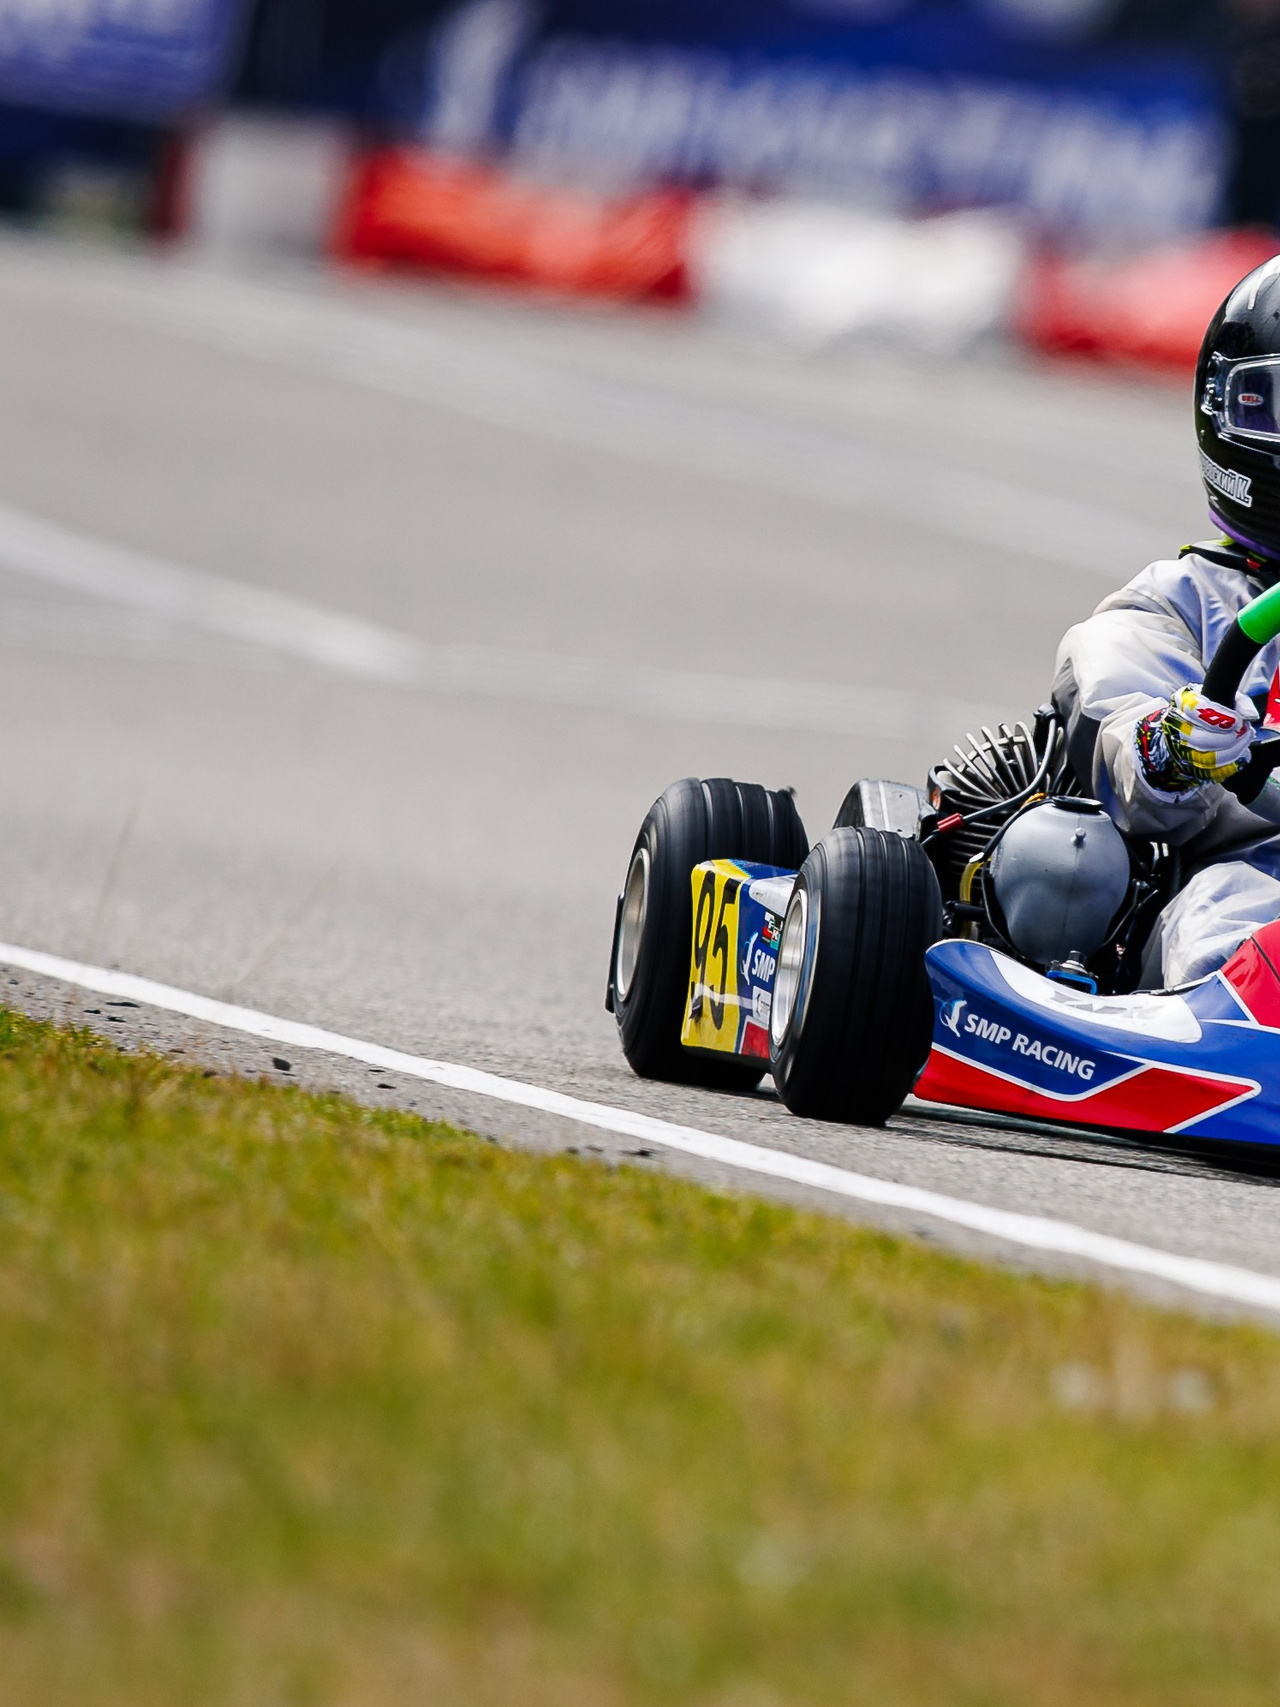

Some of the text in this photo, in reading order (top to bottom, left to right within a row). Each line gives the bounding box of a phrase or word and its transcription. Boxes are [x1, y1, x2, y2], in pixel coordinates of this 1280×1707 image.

[690, 869, 742, 1031] 95
[751, 948, 776, 983] SMP
[964, 1013, 1096, 1081] SMP RACING
